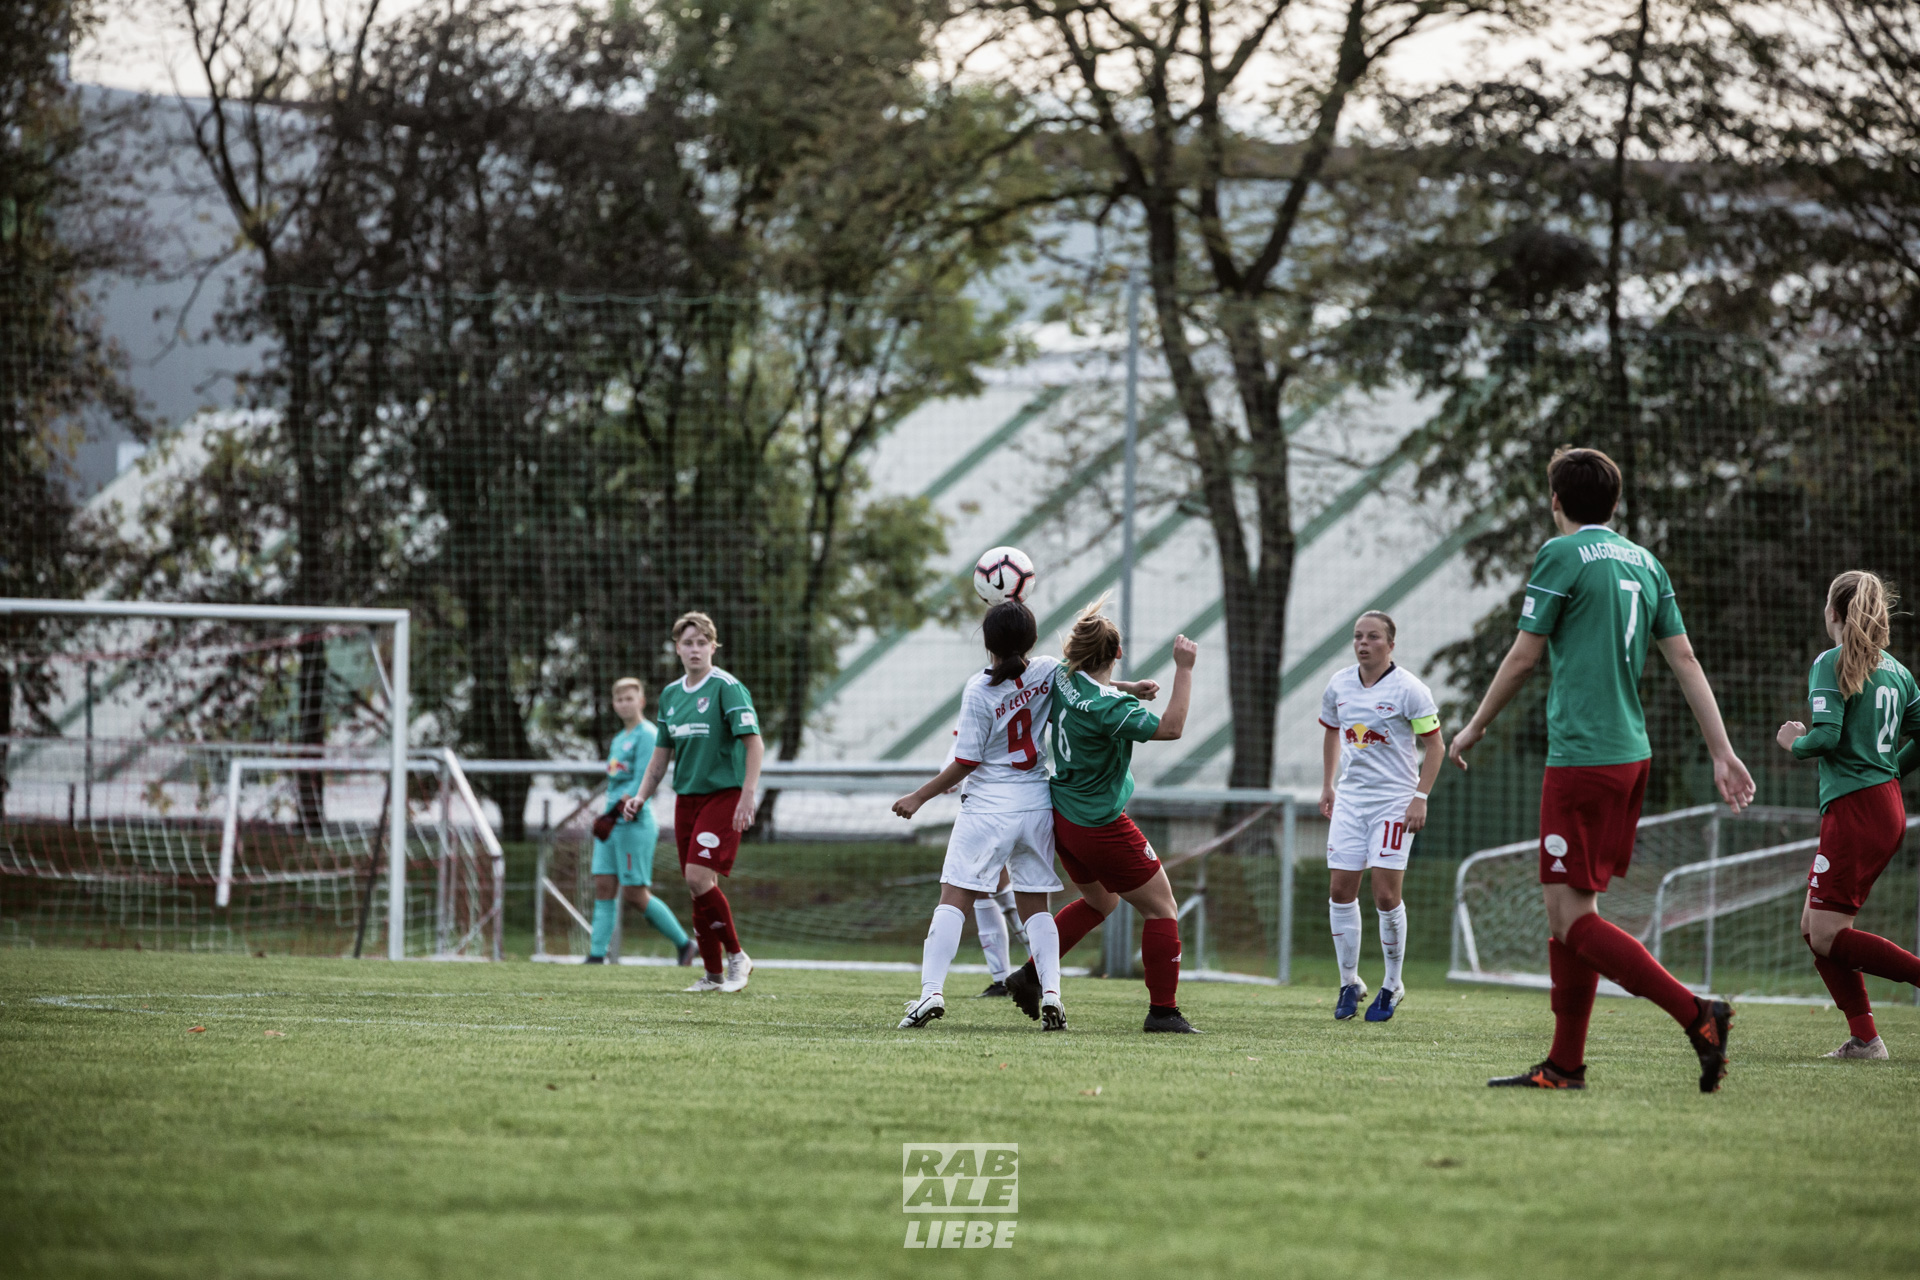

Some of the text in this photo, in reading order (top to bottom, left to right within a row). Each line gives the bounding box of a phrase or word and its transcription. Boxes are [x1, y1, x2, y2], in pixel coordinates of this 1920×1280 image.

[1619, 579, 1642, 662] 7
[995, 702, 1006, 720] RB
[1007, 708, 1038, 771] 9
[1058, 707, 1071, 762] 6
[1876, 685, 1899, 753] 21
[1382, 820, 1403, 851] 10
